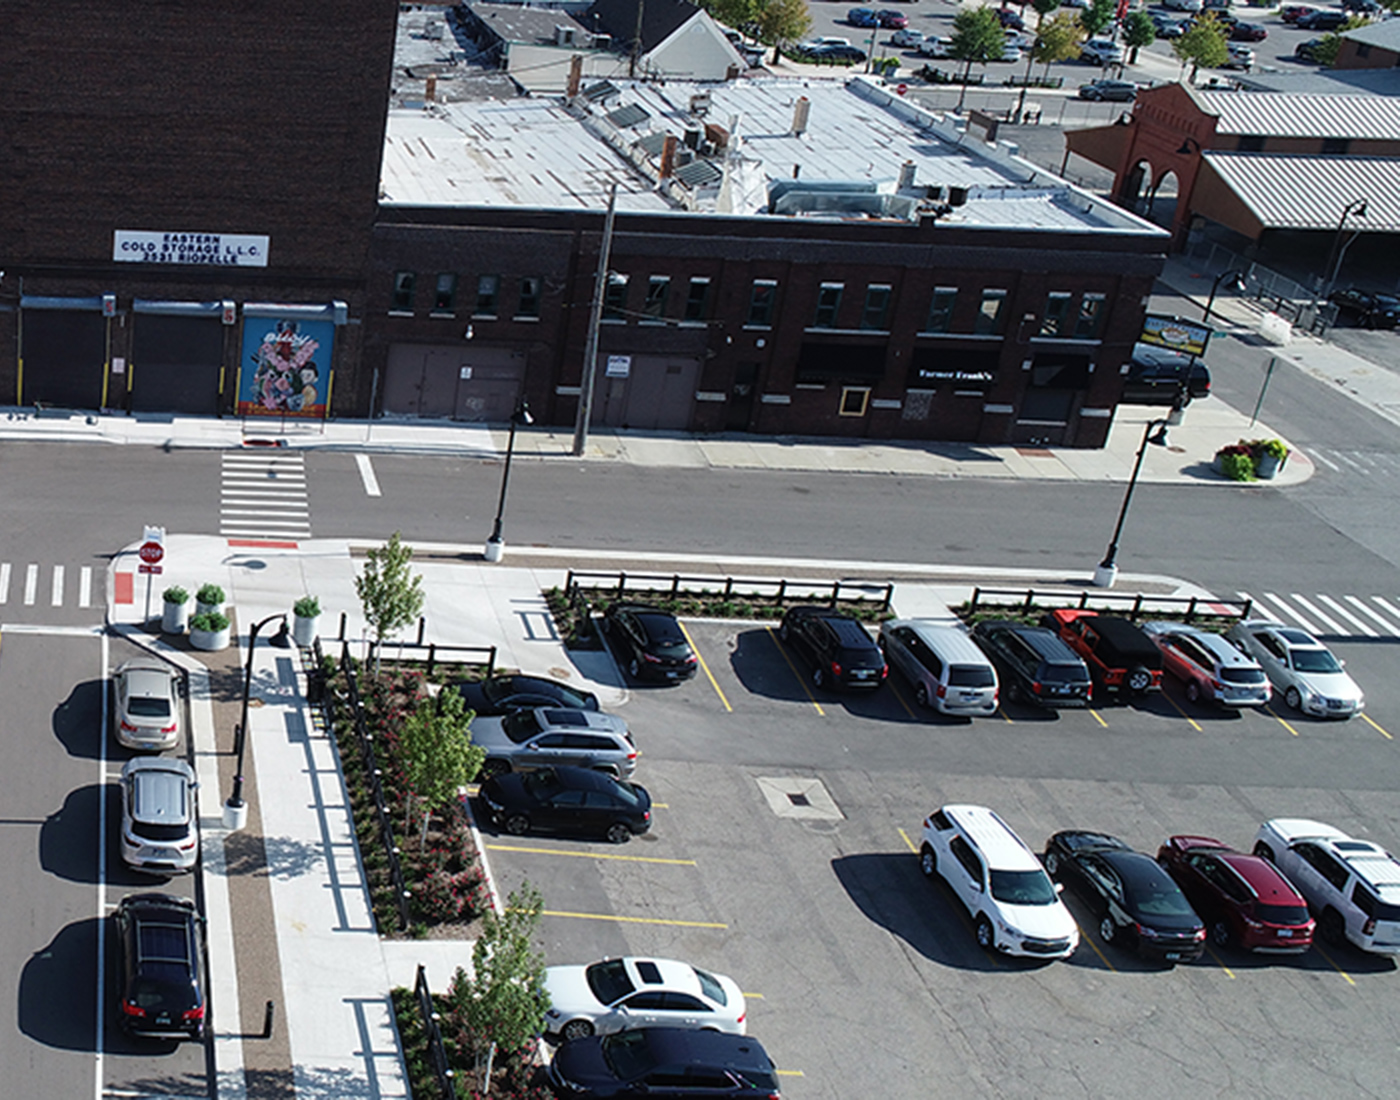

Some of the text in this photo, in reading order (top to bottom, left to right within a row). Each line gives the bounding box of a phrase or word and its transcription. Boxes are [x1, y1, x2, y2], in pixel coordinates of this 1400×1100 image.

[163, 233, 221, 245] EASTERN
[121, 241, 156, 252] COLD
[162, 242, 220, 255] STORAGE
[178, 252, 239, 265] RIOPELLE
[141, 548, 162, 558] STOP
